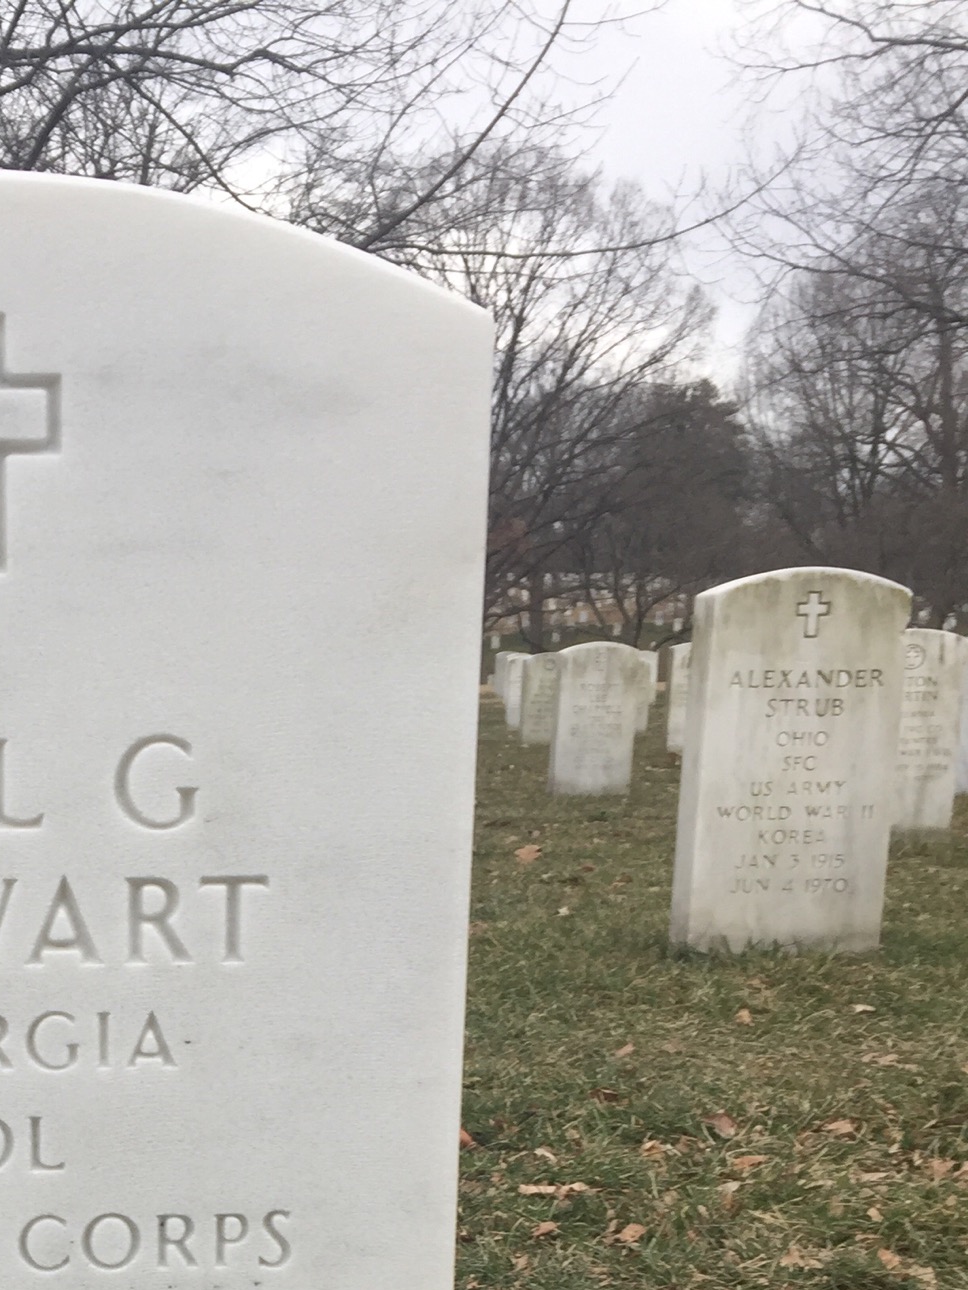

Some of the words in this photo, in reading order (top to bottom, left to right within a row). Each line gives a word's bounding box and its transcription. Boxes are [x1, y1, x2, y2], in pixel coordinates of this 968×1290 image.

[729, 669, 884, 688] ALEXANDER
[765, 698, 844, 718] STRUB
[776, 731, 829, 746] OHIO
[782, 755, 817, 771] SFC
[114, 733, 199, 830] G
[750, 781, 773, 796] US
[787, 781, 847, 795] ARMY
[717, 805, 792, 821] WORLD
[805, 805, 849, 820] WAR
[759, 829, 825, 844] KOREA
[734, 854, 780, 869] JAN
[811, 853, 845, 869] 1915
[730, 878, 771, 893] JUN
[805, 878, 849, 893] 1970
[18, 1209, 292, 1271] CORPS
